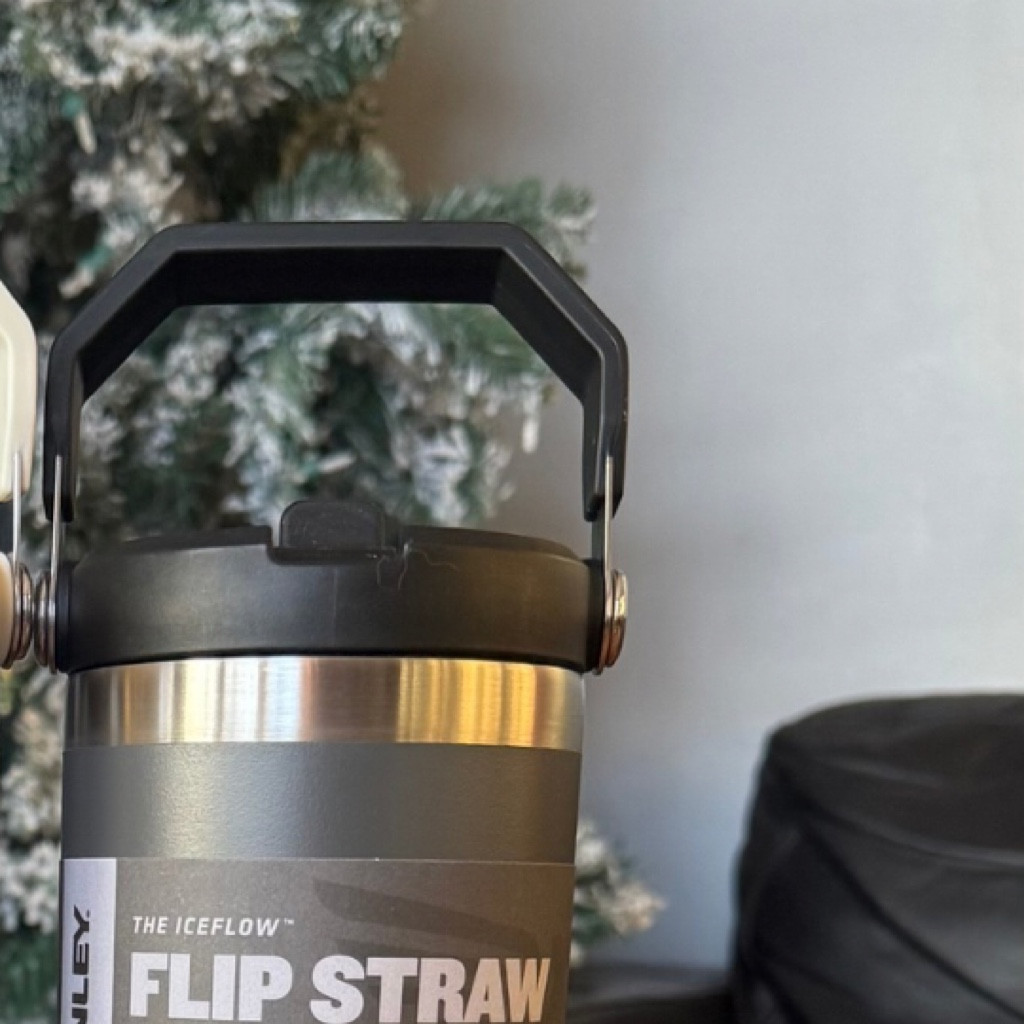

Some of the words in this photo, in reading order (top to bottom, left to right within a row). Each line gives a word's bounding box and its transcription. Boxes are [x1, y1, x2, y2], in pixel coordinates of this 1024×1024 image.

[132, 916, 168, 935] THE
[130, 952, 294, 1021] FLIP
[310, 954, 551, 1024] STRAW
